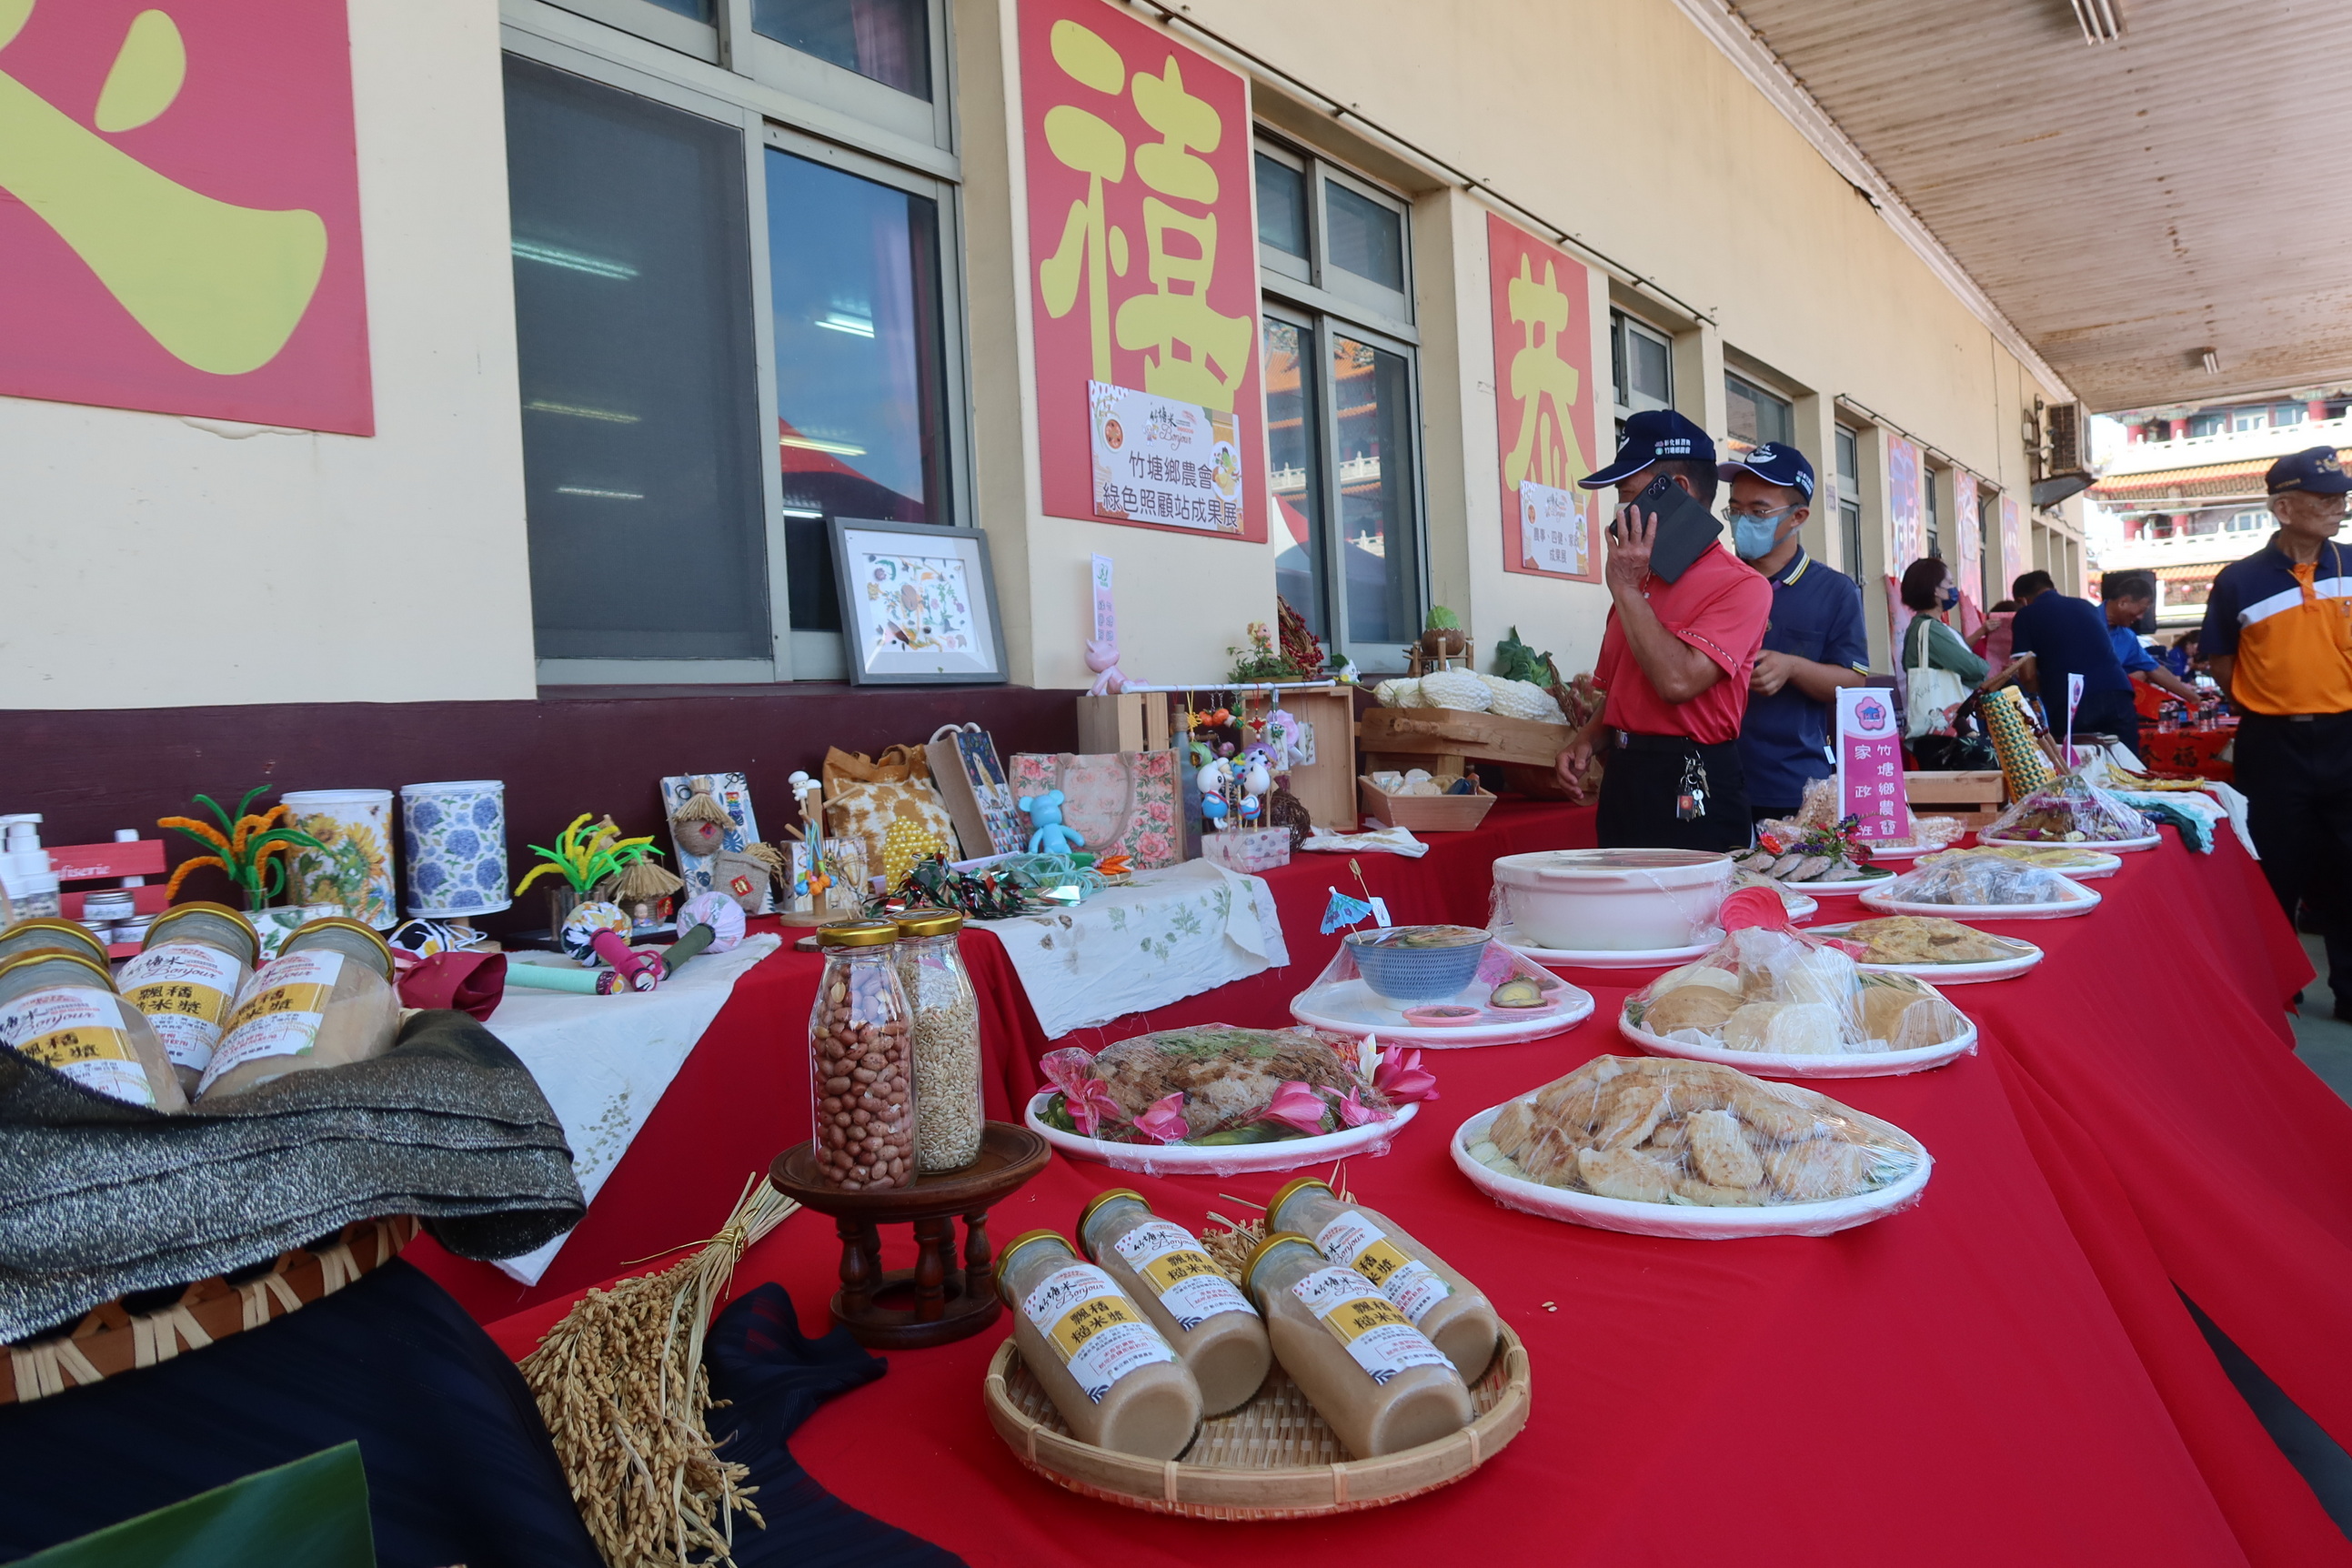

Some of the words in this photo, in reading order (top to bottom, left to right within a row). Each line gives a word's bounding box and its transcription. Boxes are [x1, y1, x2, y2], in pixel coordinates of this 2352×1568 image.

[1129, 450, 1212, 490] 竹塘鄉農會
[1102, 485, 1238, 528] 綠色照顧站成果展
[1854, 744, 1873, 837] 家政班
[1877, 744, 1896, 836] 竹塘鄉農會
[140, 964, 217, 980] Bonjour
[1366, 1258, 1396, 1286] 米漿
[1056, 1283, 1105, 1309] Bonjour
[1071, 1310, 1127, 1344] 糙米漿
